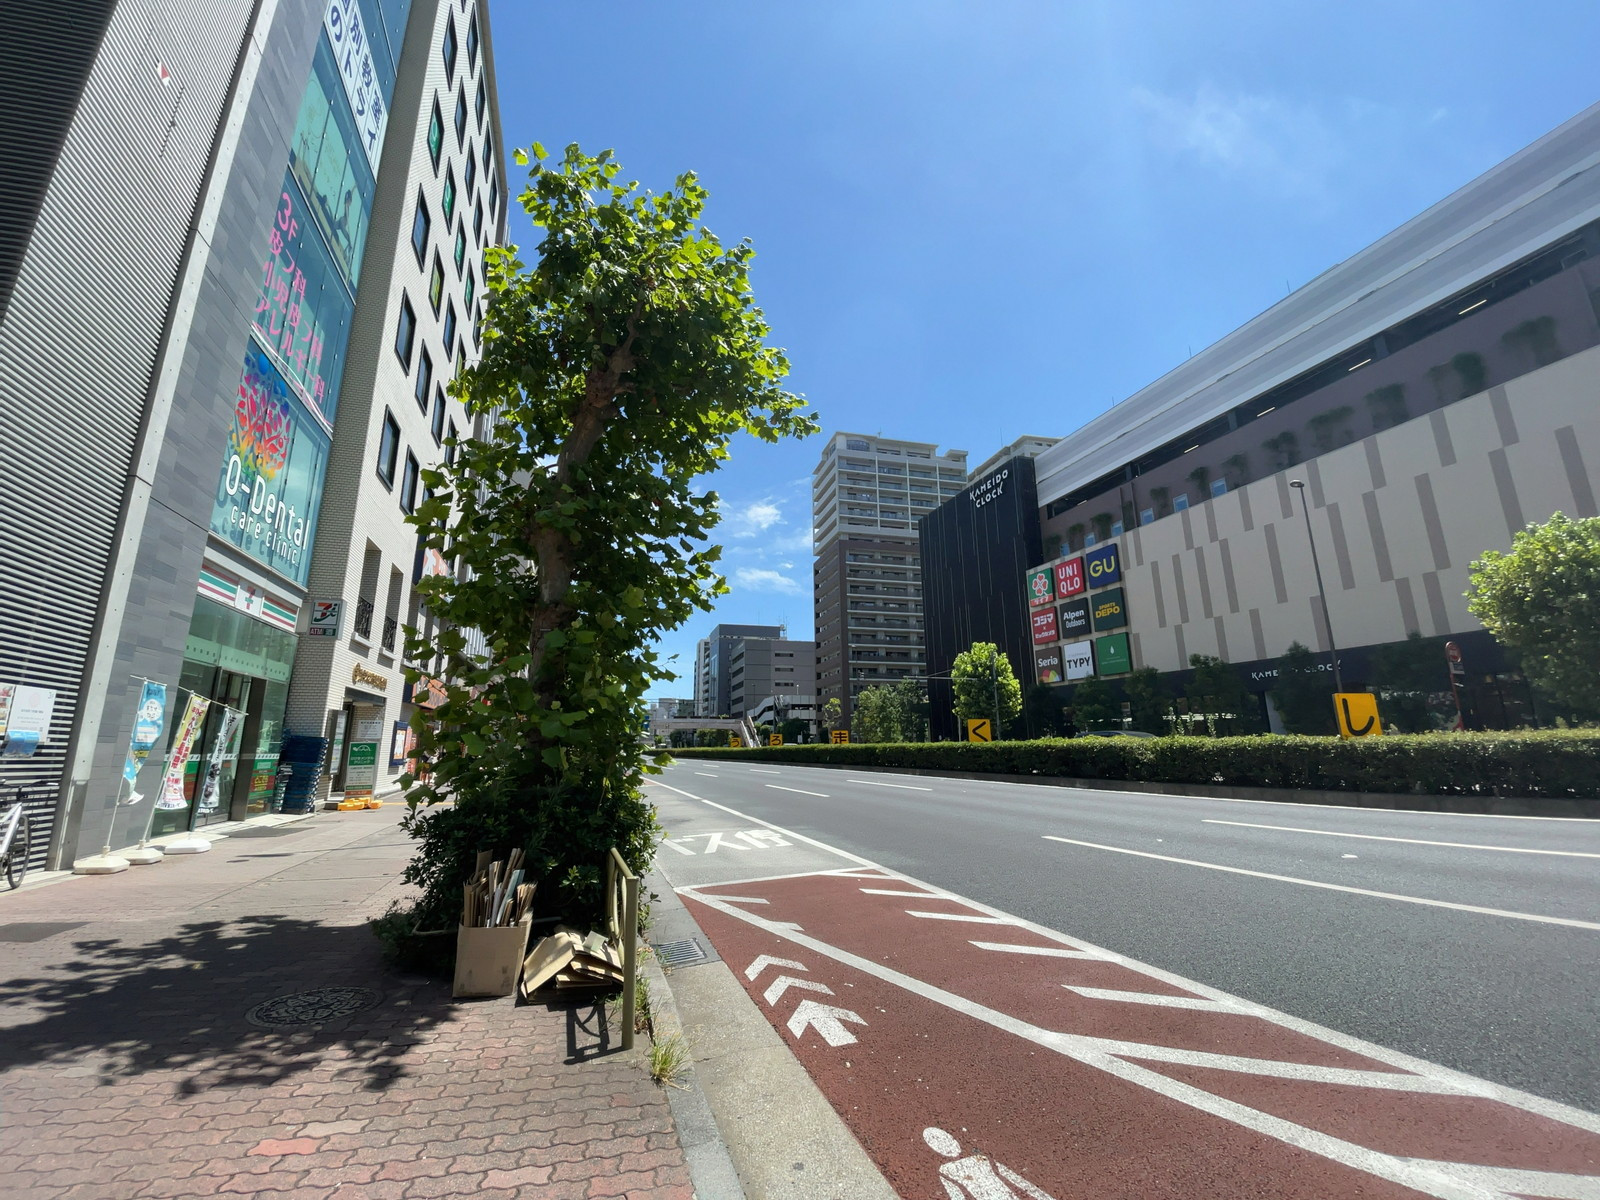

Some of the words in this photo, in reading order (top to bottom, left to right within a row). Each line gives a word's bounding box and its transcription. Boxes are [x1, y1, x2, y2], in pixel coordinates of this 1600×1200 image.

[331, 6, 376, 151] のトライ
[278, 192, 298, 241] 3F
[269, 227, 307, 302] 皮フ科
[262, 260, 323, 366] 小児皮フ科
[969, 469, 1009, 502] KAMEIDO
[975, 481, 1004, 508] CLOCK
[226, 454, 310, 550] O-Dental
[230, 505, 262, 539] care
[265, 531, 297, 564] clinic
[1059, 563, 1078, 580] UNI
[1089, 556, 1115, 578] GU
[1060, 578, 1081, 594] QLO
[1033, 613, 1054, 627] コジマ
[1063, 609, 1085, 620] Alpen
[1095, 606, 1121, 618] DEPO
[1065, 618, 1086, 629] Outdoors
[1038, 656, 1058, 668] Seria
[1067, 656, 1090, 669] TYPY
[1342, 698, 1375, 737] し
[771, 735, 781, 746] ろ
[832, 731, 848, 744] 走
[971, 721, 988, 742] く
